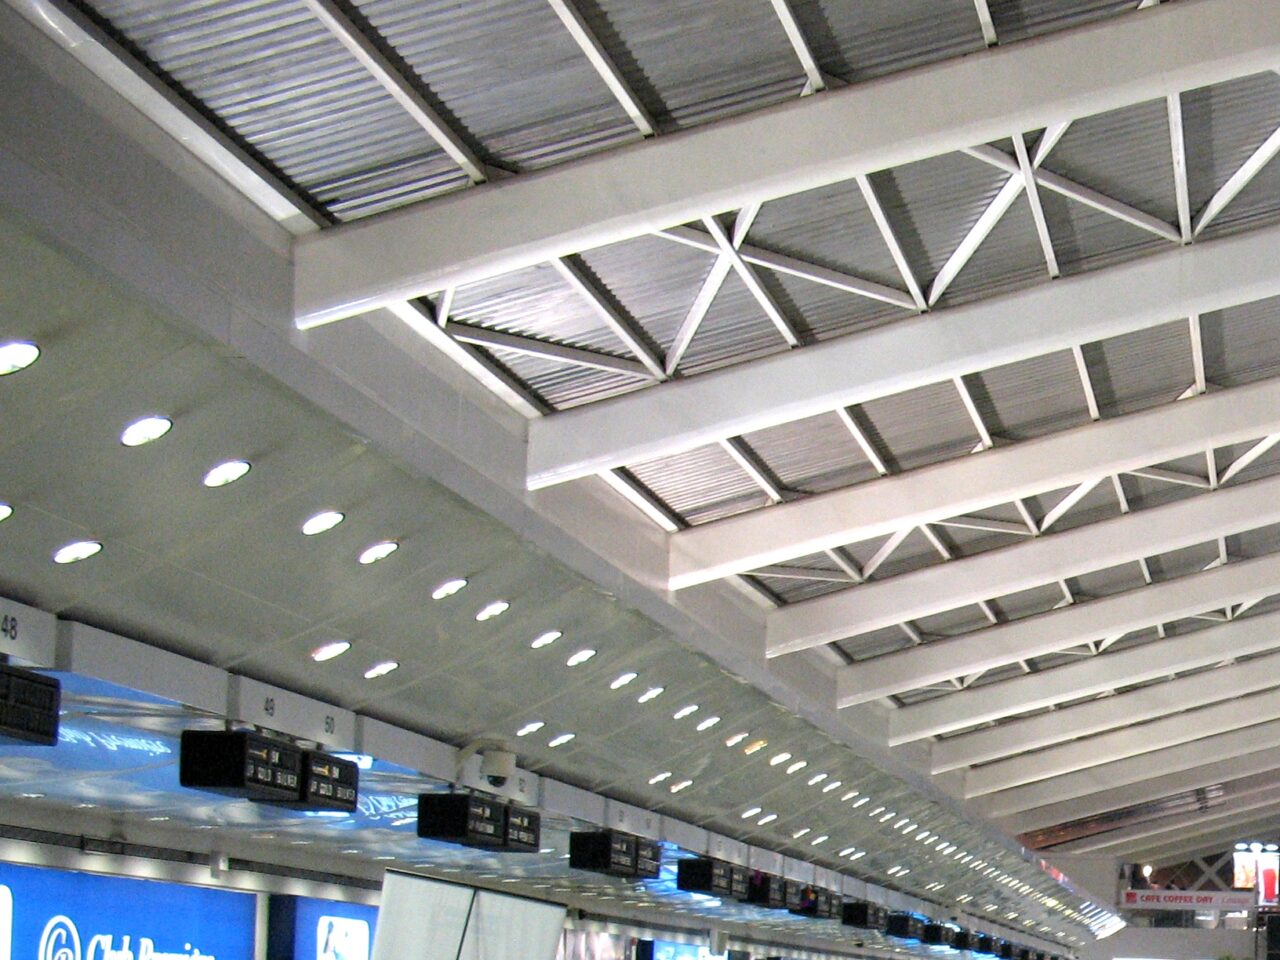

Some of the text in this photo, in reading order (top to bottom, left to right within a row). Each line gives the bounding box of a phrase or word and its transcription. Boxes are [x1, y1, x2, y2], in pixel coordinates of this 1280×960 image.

[1, 614, 18, 640] 48
[264, 697, 275, 717] 49
[1163, 895, 1193, 903] COFFEE
[1196, 896, 1214, 904] DAY
